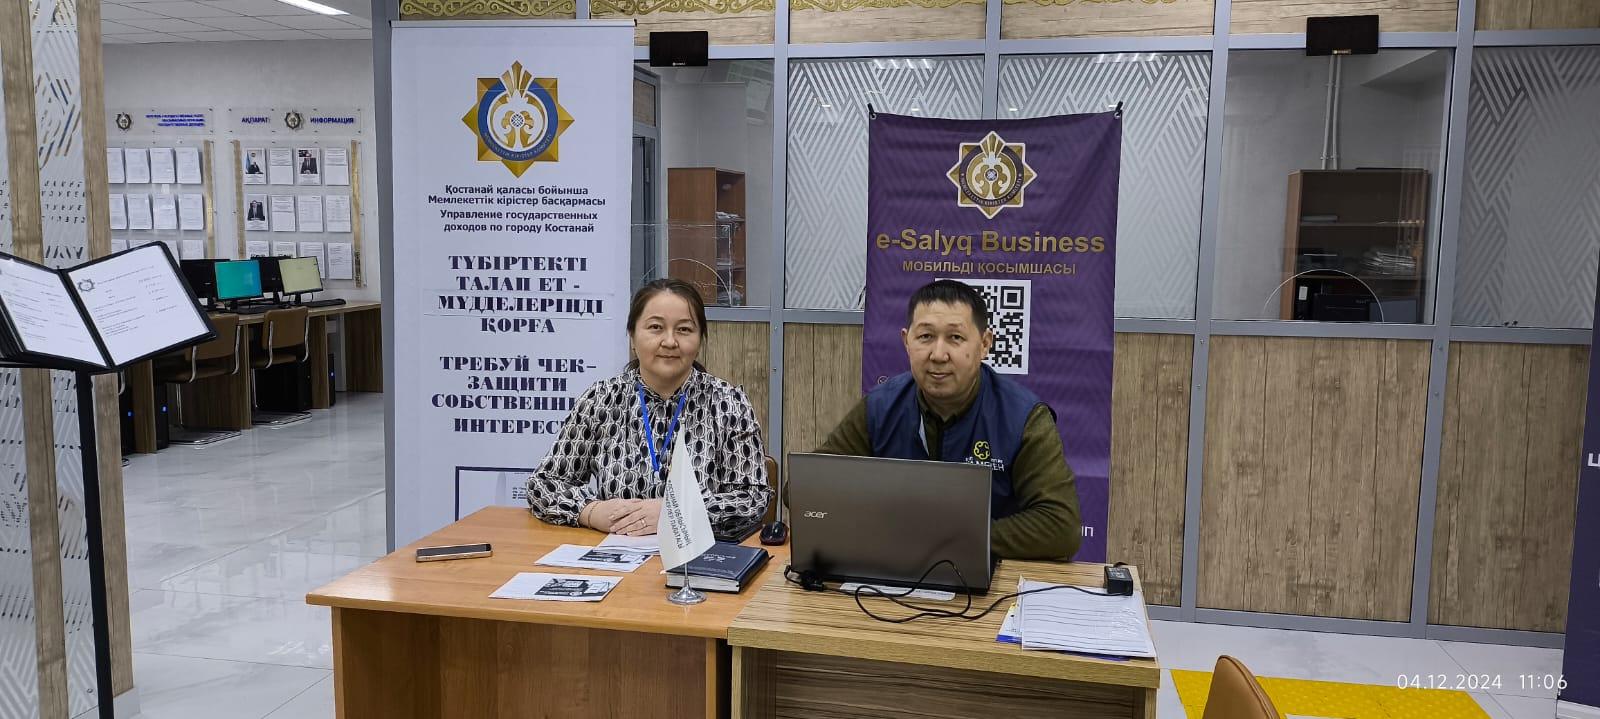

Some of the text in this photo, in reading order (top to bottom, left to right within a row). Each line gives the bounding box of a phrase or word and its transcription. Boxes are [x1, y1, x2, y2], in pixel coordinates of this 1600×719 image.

[310, 117, 355, 125] ИНФОРМАЦИЯ
[445, 184, 589, 196] Қостанай қаласы бойынша
[428, 195, 606, 207] Мемлекеттік кірістер басқармасы
[440, 209, 598, 222] Управление государственных
[444, 223, 595, 234] доходов по городу Костанай
[876, 229, 1105, 256] e-Salyq Business
[448, 255, 588, 272] ТҮБІРТЕКТІ
[903, 261, 1076, 276] МОБИЛЬДІ ҚОСЫМШАСЫ
[456, 277, 531, 292] ТАЛАП
[540, 278, 567, 292] ЕТ
[481, 318, 556, 334] ҚОРҒА
[440, 356, 530, 372] ТРЕБУЙ
[467, 376, 567, 392] ЗАЩИТИ
[454, 418, 563, 435] ИНТЕРЕС
[804, 511, 828, 519] acer
